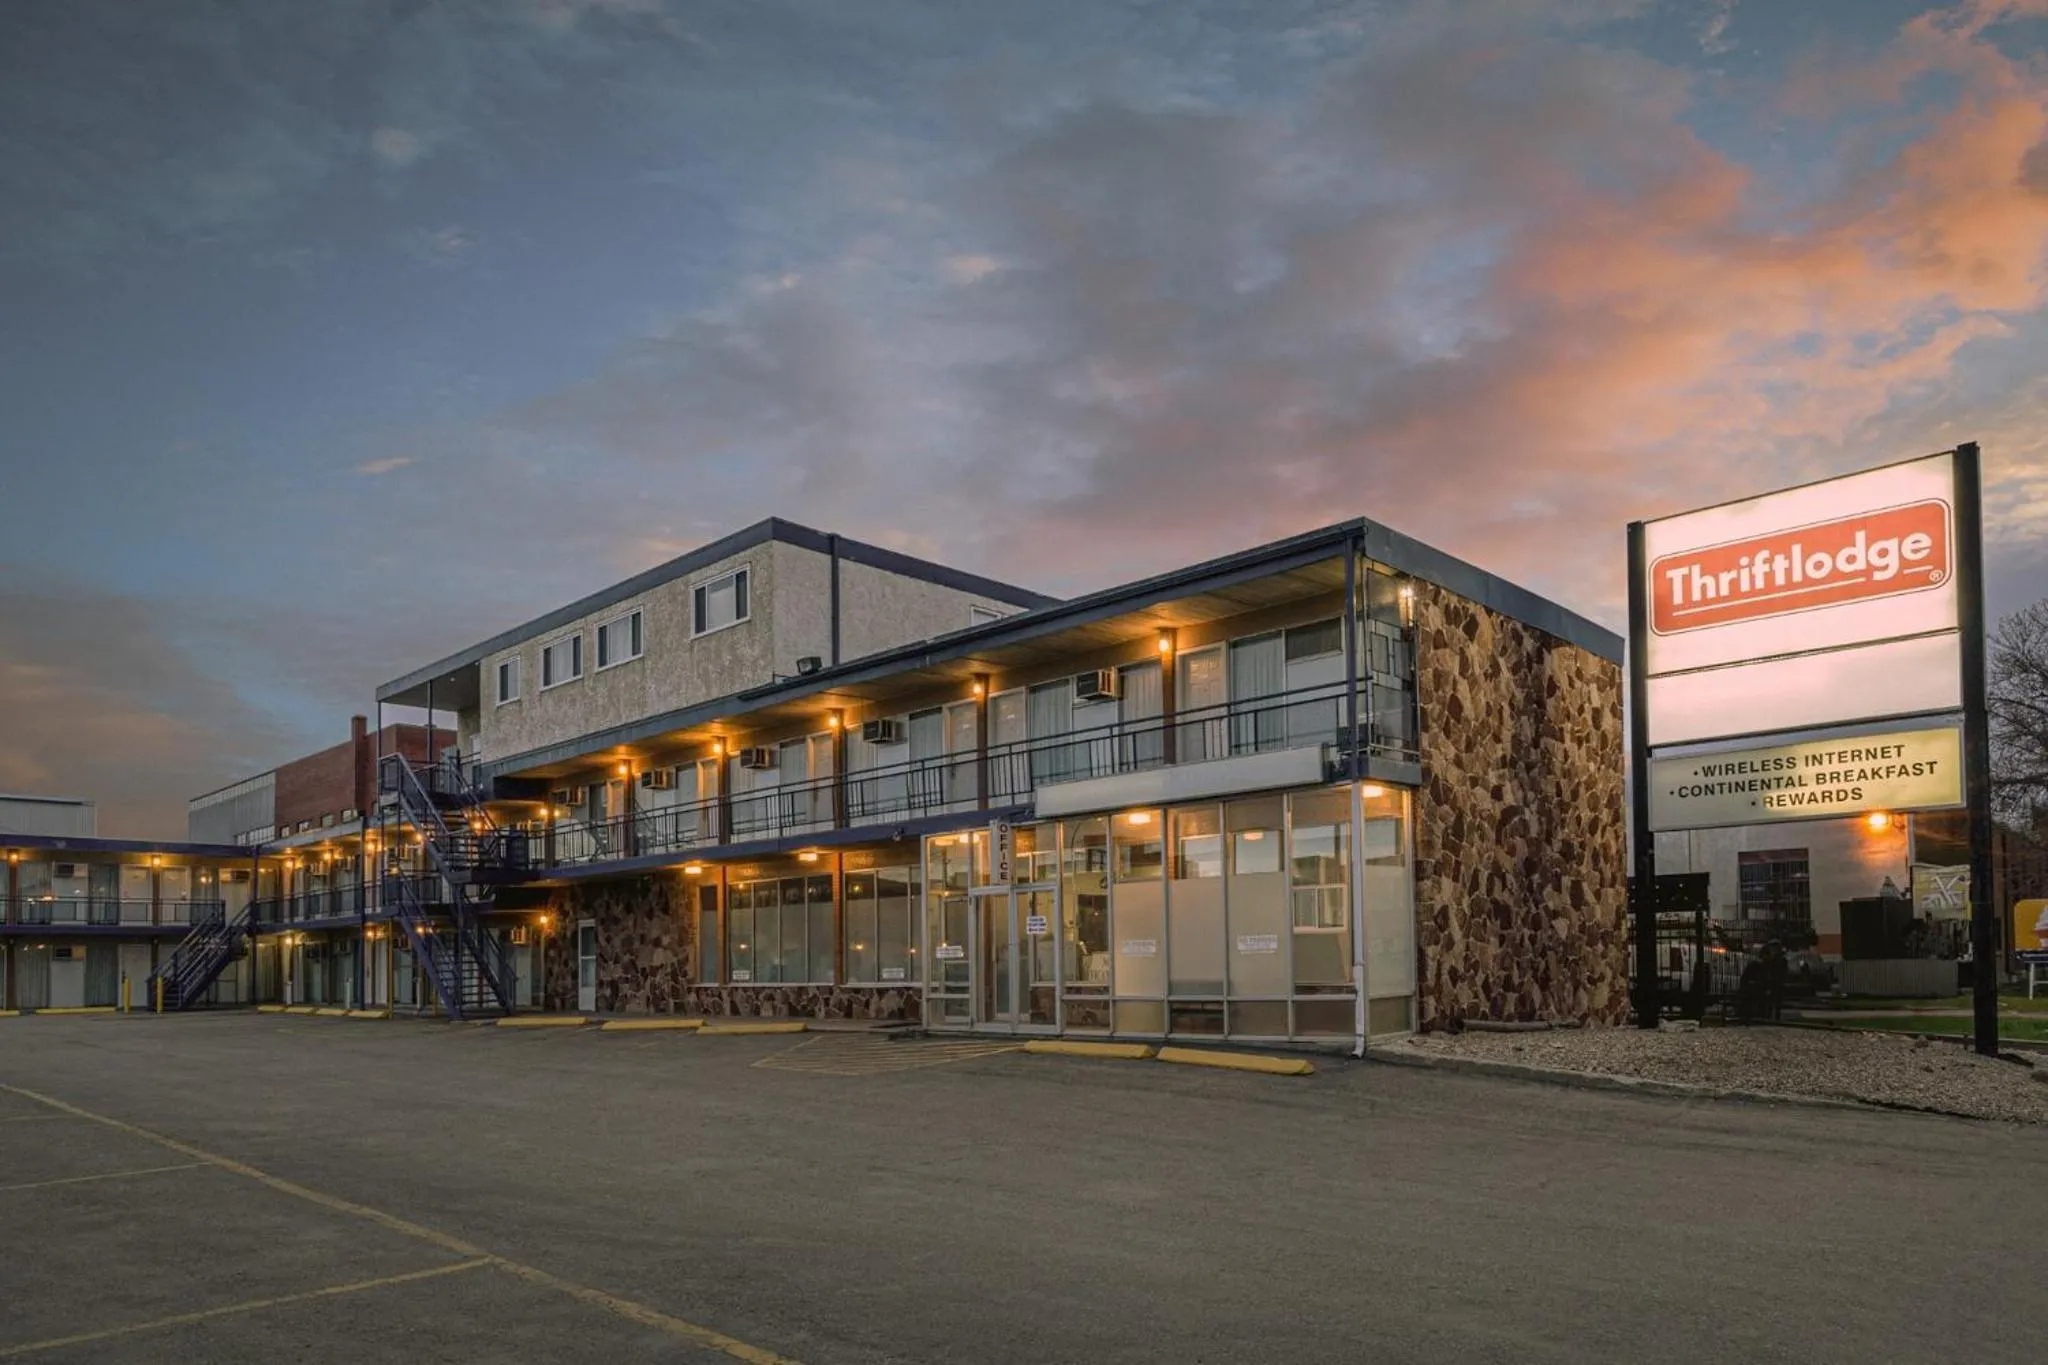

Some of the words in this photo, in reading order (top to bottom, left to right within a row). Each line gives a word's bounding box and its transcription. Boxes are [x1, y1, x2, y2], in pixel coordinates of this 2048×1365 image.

[1666, 530, 1932, 604] Thriftlodge
[1702, 756, 1797, 777] WIRELESS
[1804, 744, 1905, 767] INTERNET
[1678, 775, 1808, 798] CONTINENTAL
[1815, 761, 1938, 786] BREAKFAST
[1763, 787, 1863, 808] REWARDS
[1000, 824, 1009, 880] OFFICE
